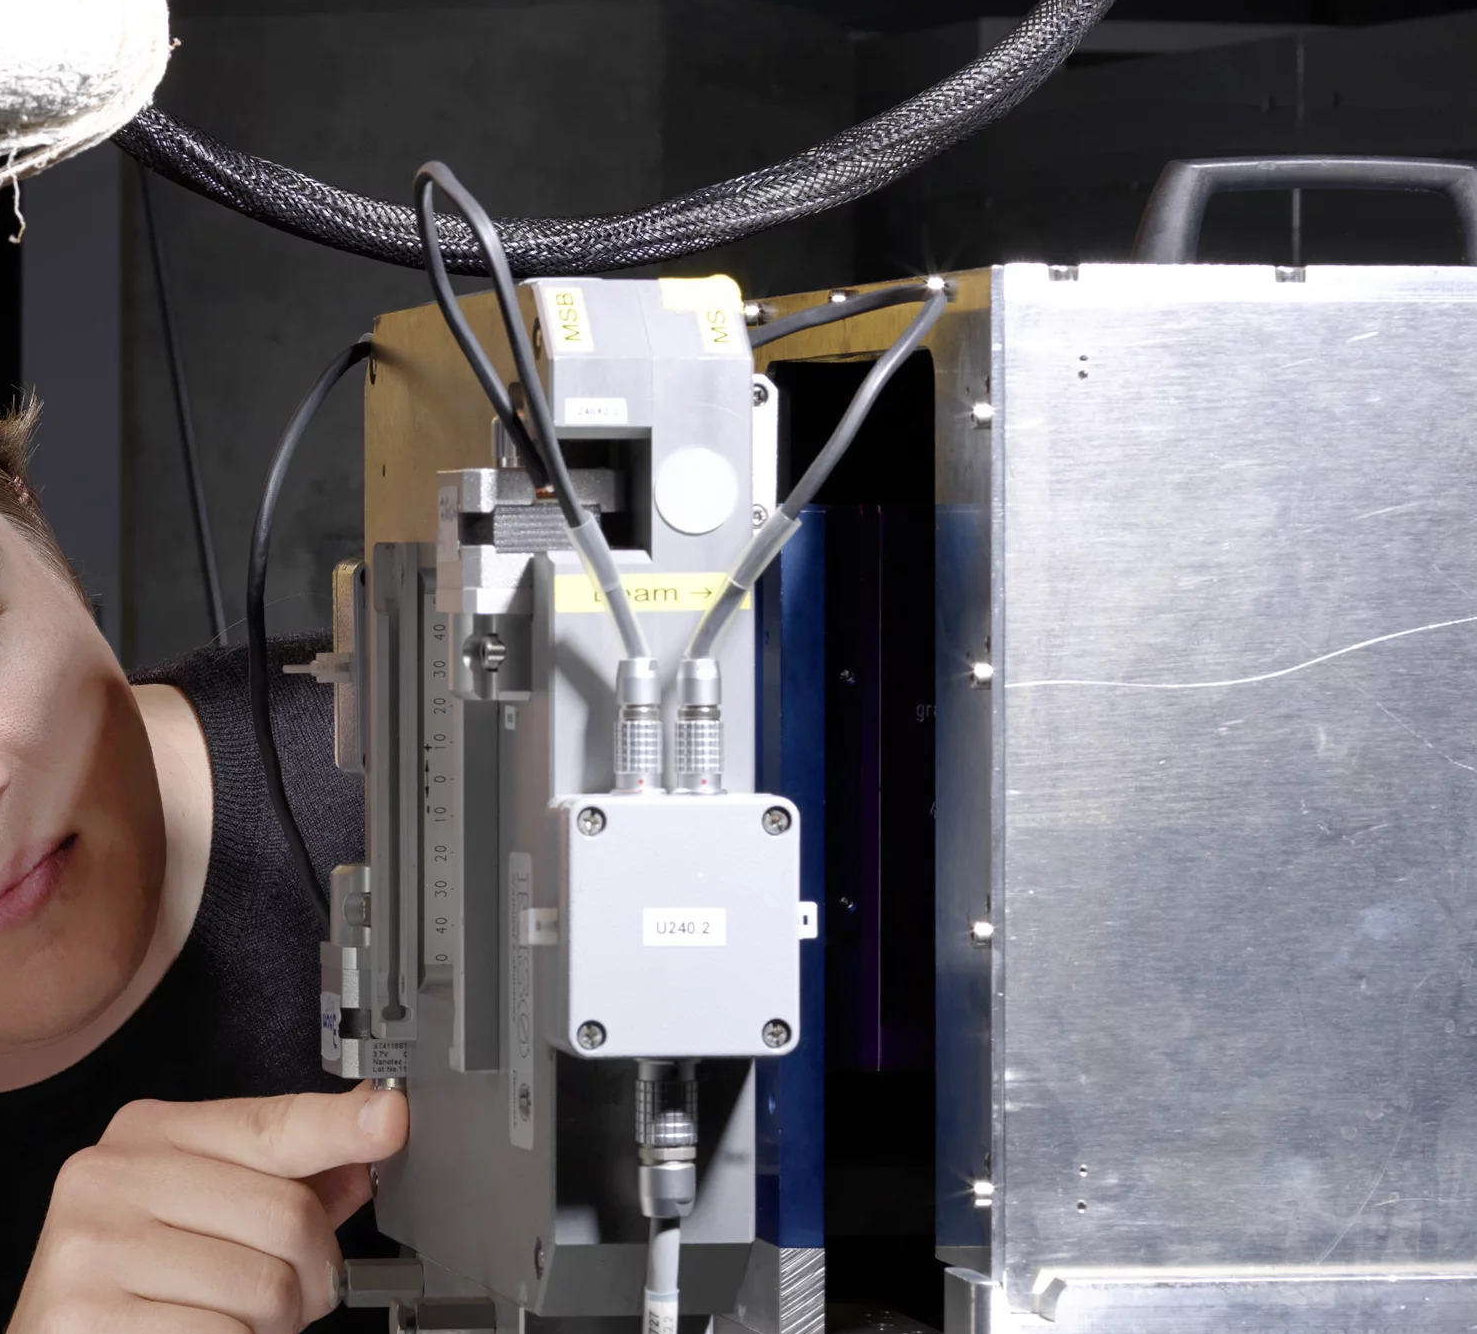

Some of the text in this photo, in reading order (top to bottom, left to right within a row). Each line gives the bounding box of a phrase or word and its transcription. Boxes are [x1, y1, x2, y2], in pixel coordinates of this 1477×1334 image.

[555, 292, 581, 342] MSB
[433, 624, 446, 641] 40
[433, 660, 446, 678] 30
[433, 697, 446, 714] 20
[433, 733, 446, 749] 10
[433, 806, 447, 822] 10
[434, 845, 447, 862] 20
[434, 880, 448, 898] 30
[435, 917, 448, 934] 40
